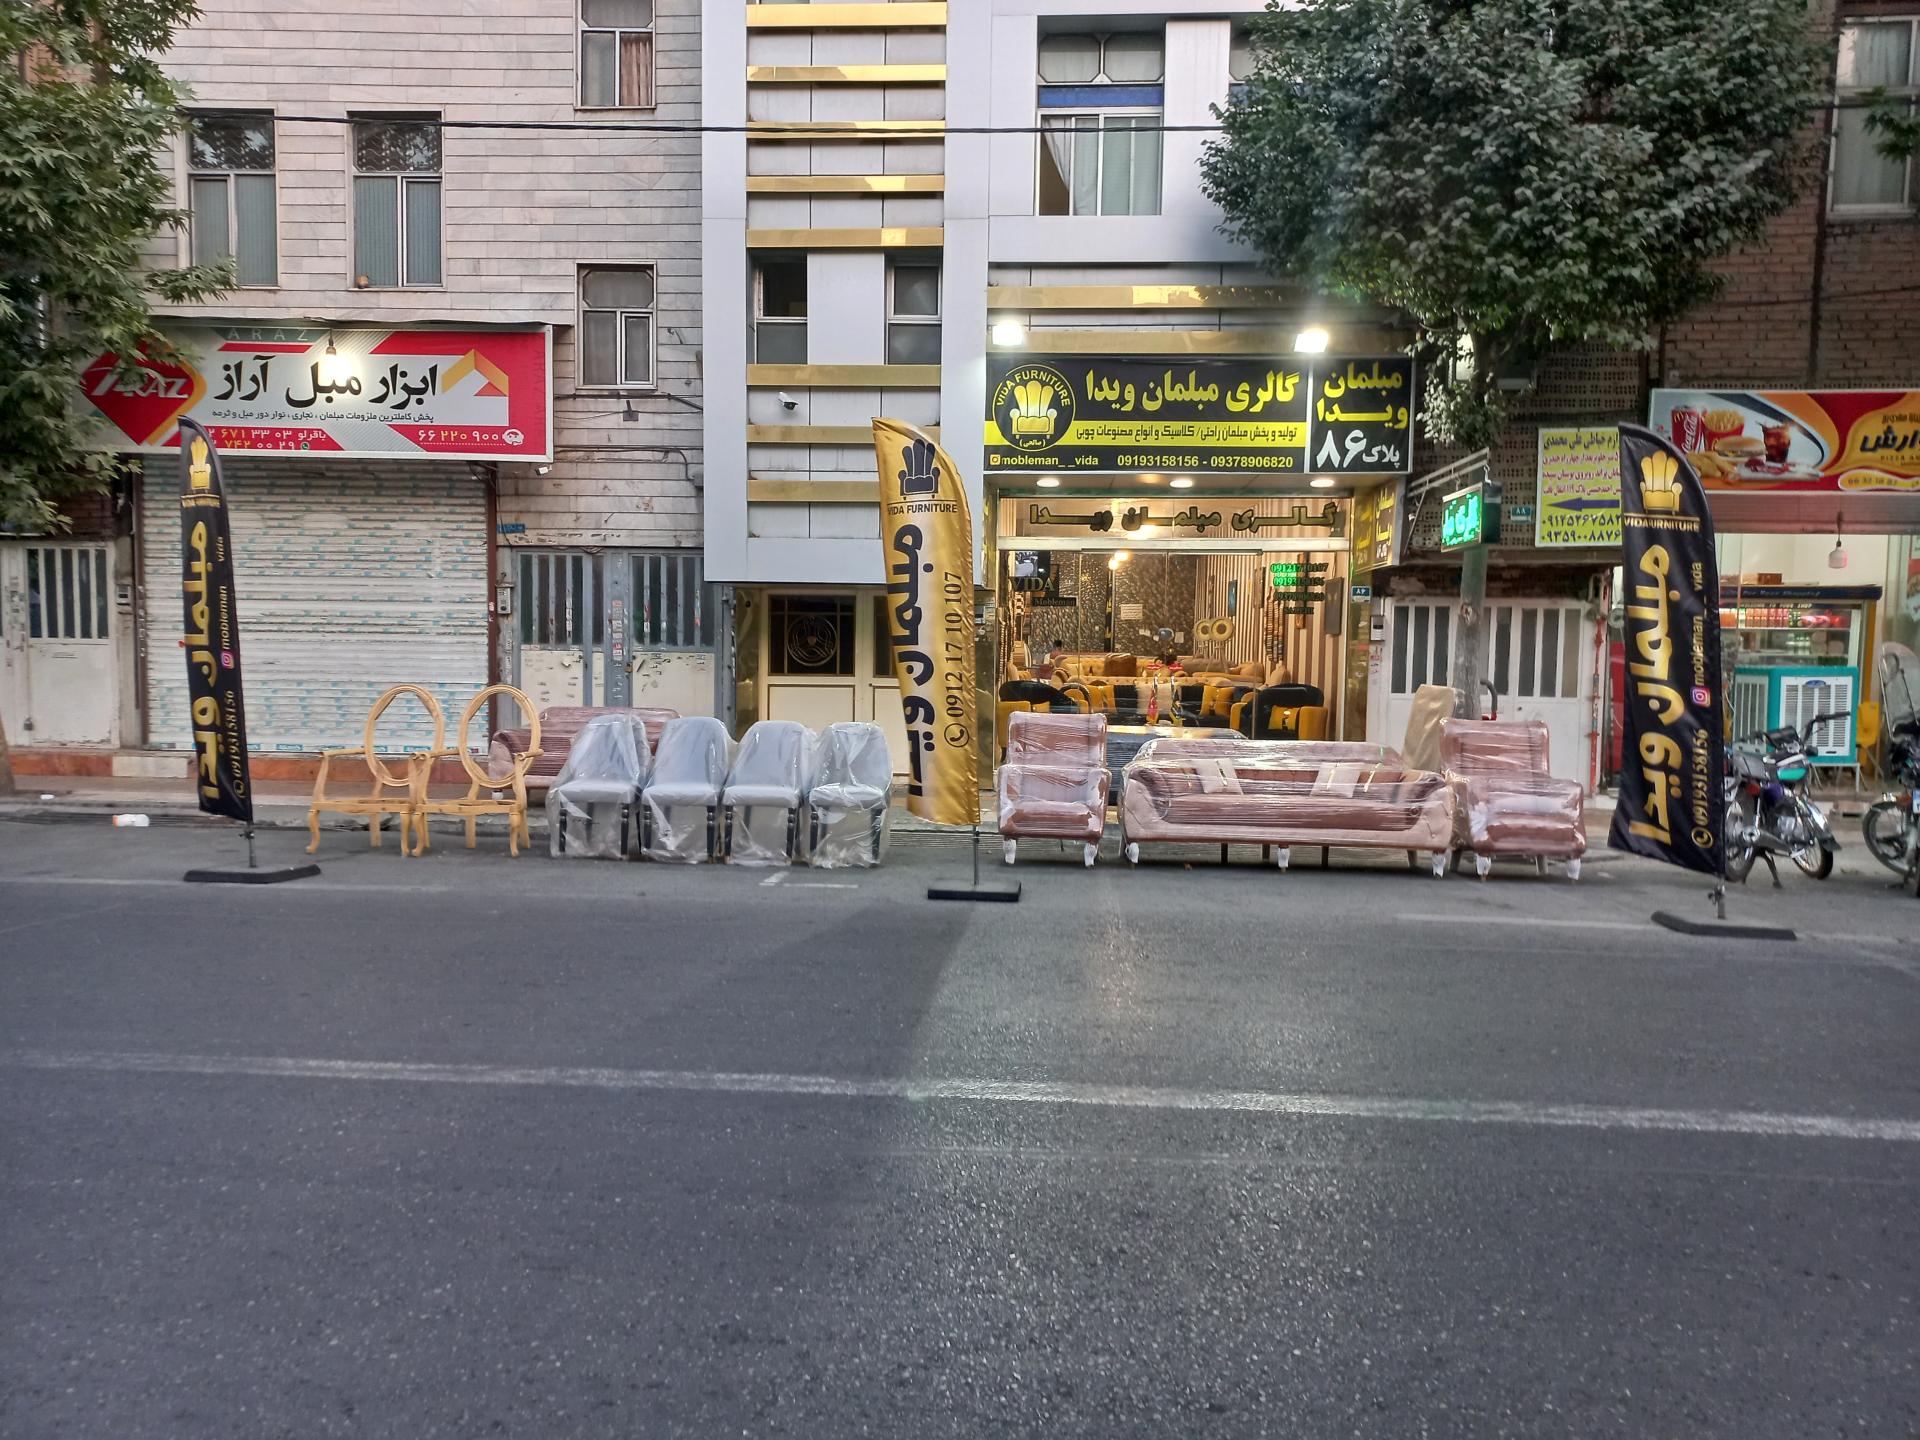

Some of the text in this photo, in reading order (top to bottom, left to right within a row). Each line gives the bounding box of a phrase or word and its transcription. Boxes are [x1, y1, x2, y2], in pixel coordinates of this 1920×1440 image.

[228, 328, 309, 341] ARAZ
[213, 354, 438, 410] ابزار مبل آراز
[996, 369, 1071, 407] VIDA FURNITURE
[1086, 369, 1299, 413] گالری مبلمان ویدا
[1316, 361, 1408, 429] مبلمان ویدا
[238, 410, 253, 419] مبل
[256, 411, 269, 419] دور
[271, 411, 286, 420] نوار
[292, 411, 313, 420] نجاری
[320, 412, 344, 422] مبلمان
[346, 412, 377, 422] ملزومات
[380, 413, 411, 422] کاملترین
[412, 414, 434, 424] پخش
[221, 429, 245, 439] ۶۷۱
[251, 429, 270, 439] ۳۳
[275, 430, 292, 439] ۰۳
[298, 430, 326, 441] باقرلو
[418, 430, 499, 441] ۶۶ ۲۲۰ ۹۰۰
[1076, 427, 1095, 441] چوبی
[1096, 425, 1133, 437] مصنوعات
[1135, 425, 1153, 442] انواع
[1154, 430, 1159, 439] و
[1161, 425, 1194, 439] کلاسیک
[1222, 425, 1247, 440] مبلمان
[1249, 426, 1270, 441] پخش
[1271, 430, 1276, 440] و
[1281, 426, 1297, 442] تولید
[1316, 429, 1400, 468] پلاک ۸۶
[1117, 455, 1199, 467] 09193158156
[1210, 455, 1293, 468] 09378906820
[906, 503, 957, 514] FURNITURE
[1029, 504, 1113, 532] ویدا
[1121, 506, 1222, 533] مبلمان
[1231, 501, 1337, 533] گالری
[1623, 516, 1700, 533] VIDA URNITURE
[1013, 577, 1054, 592] VIDA
[183, 521, 217, 687] مبلمان
[888, 524, 934, 687] مبلمان
[944, 571, 964, 718] 0912 17 10 107
[1626, 544, 1684, 846] مبلمان ویدا
[192, 696, 224, 800] ویدا
[1692, 728, 1708, 827] 09193158156
